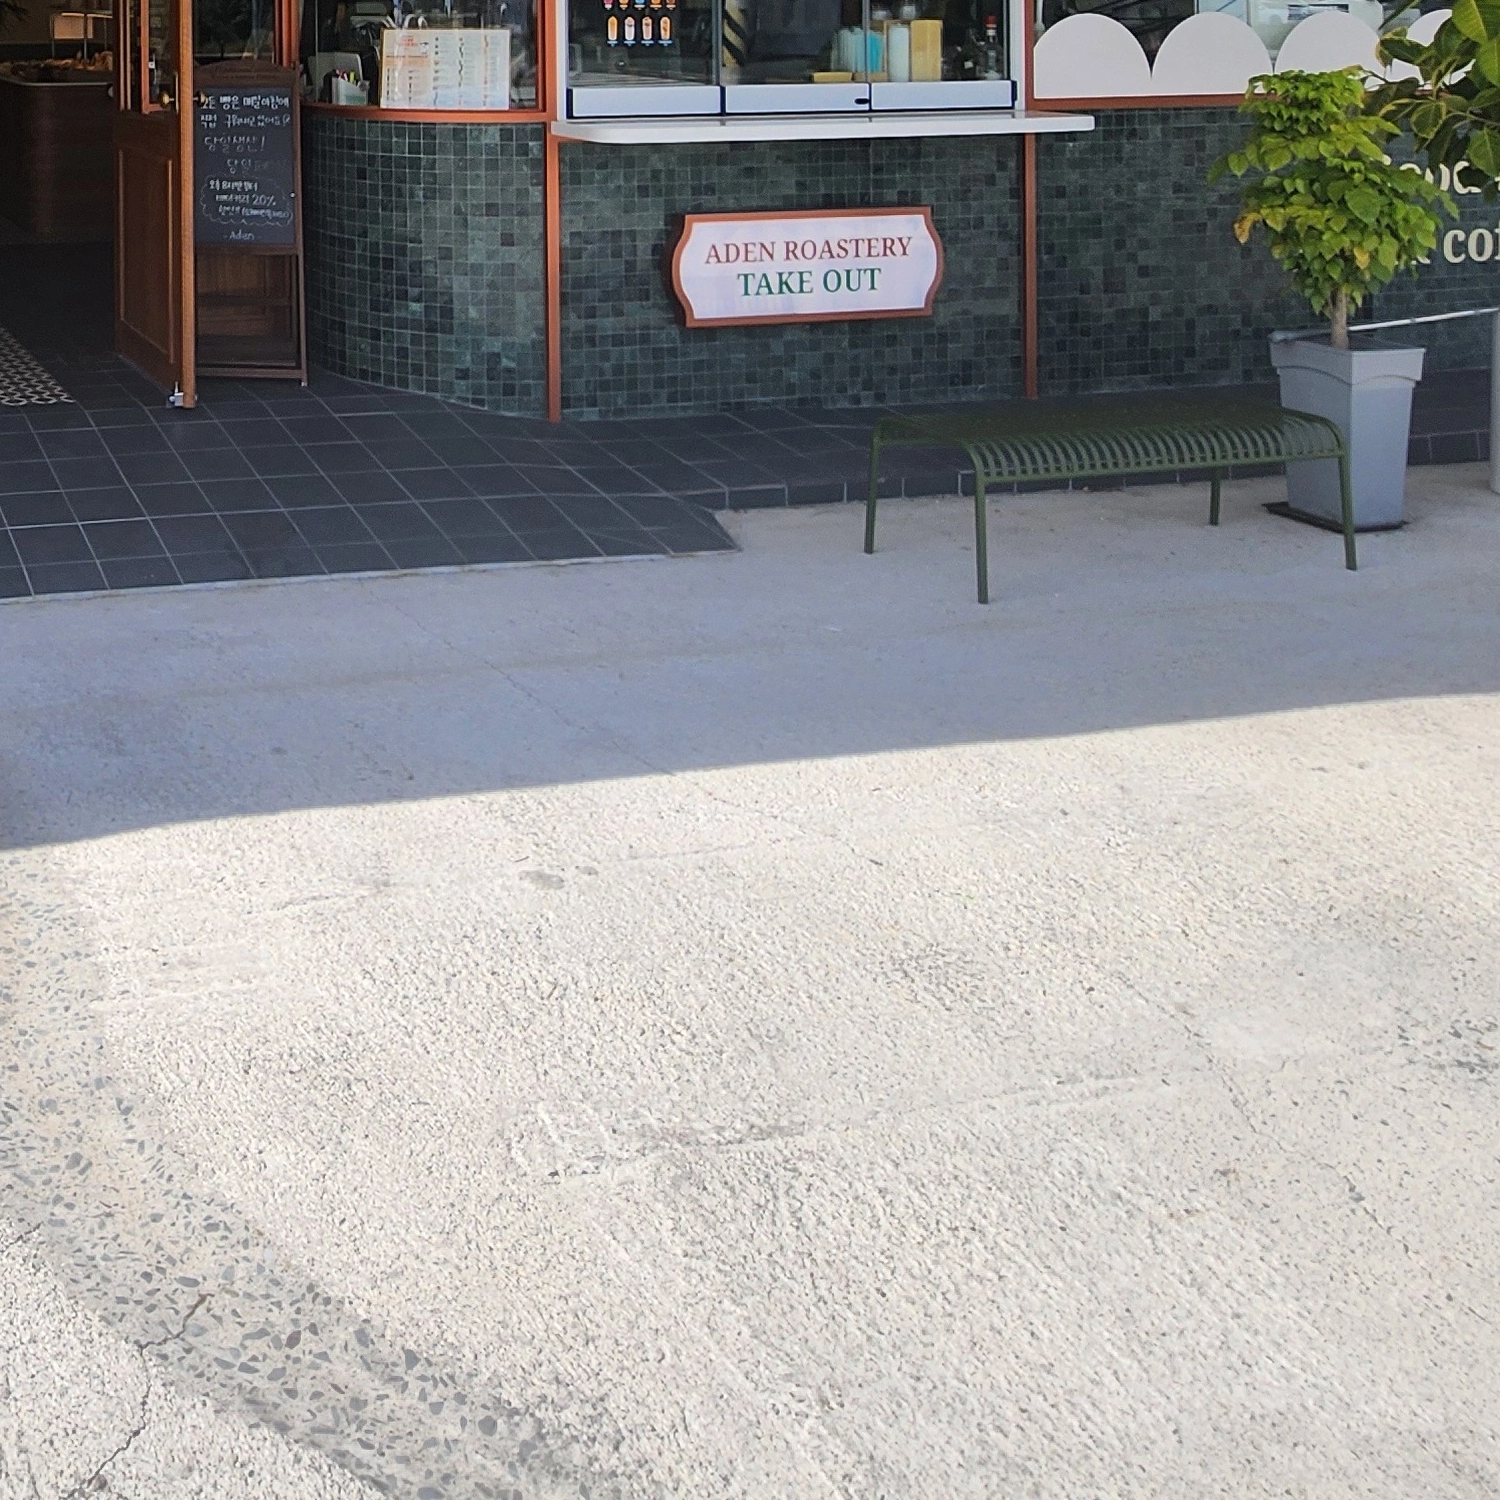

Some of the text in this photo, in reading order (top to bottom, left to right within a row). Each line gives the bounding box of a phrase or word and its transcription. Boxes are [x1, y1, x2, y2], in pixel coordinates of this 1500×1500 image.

[252, 193, 277, 207] 20%
[230, 228, 255, 241] Aden
[704, 235, 913, 265] ADEN ROASTERY
[737, 267, 882, 297] TAKE OUT
